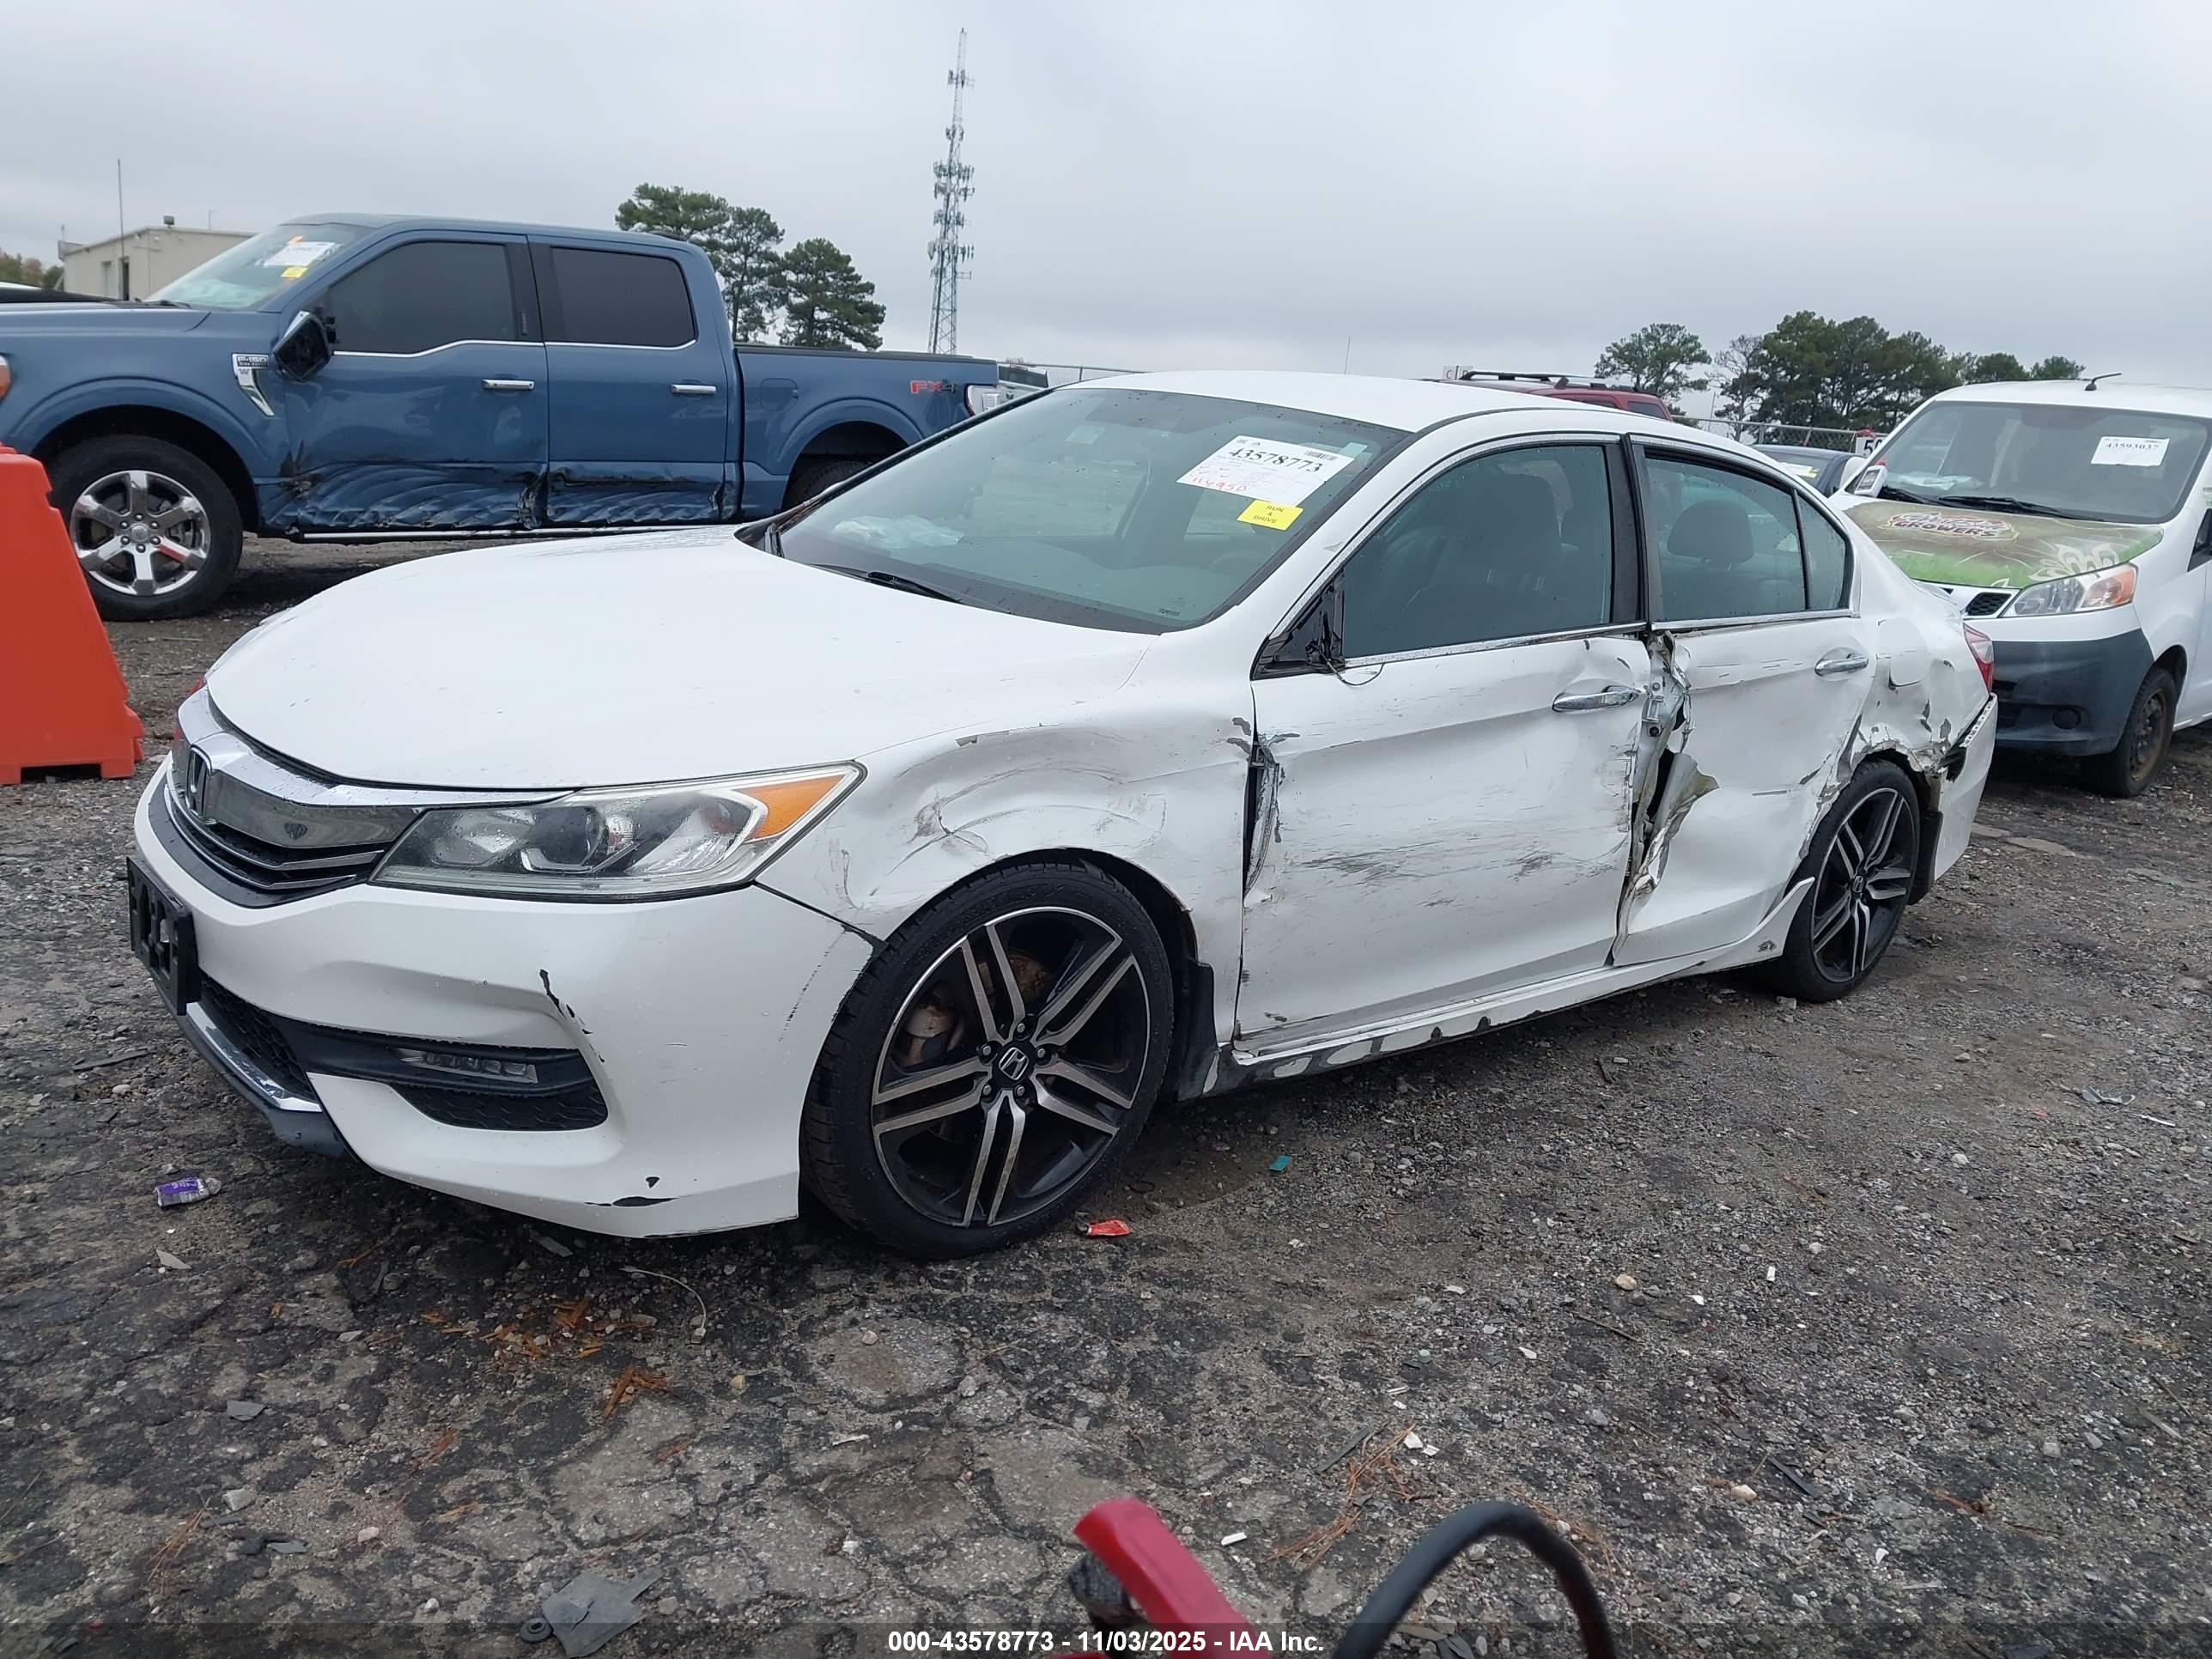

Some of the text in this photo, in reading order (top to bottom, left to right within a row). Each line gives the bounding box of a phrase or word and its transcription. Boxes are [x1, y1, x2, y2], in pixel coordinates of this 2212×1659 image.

[910, 380, 954, 394] FX4
[1229, 447, 1322, 472] 43578773
[1253, 514, 1279, 524] DRIVE
[1894, 520, 1996, 537] GROWERS
